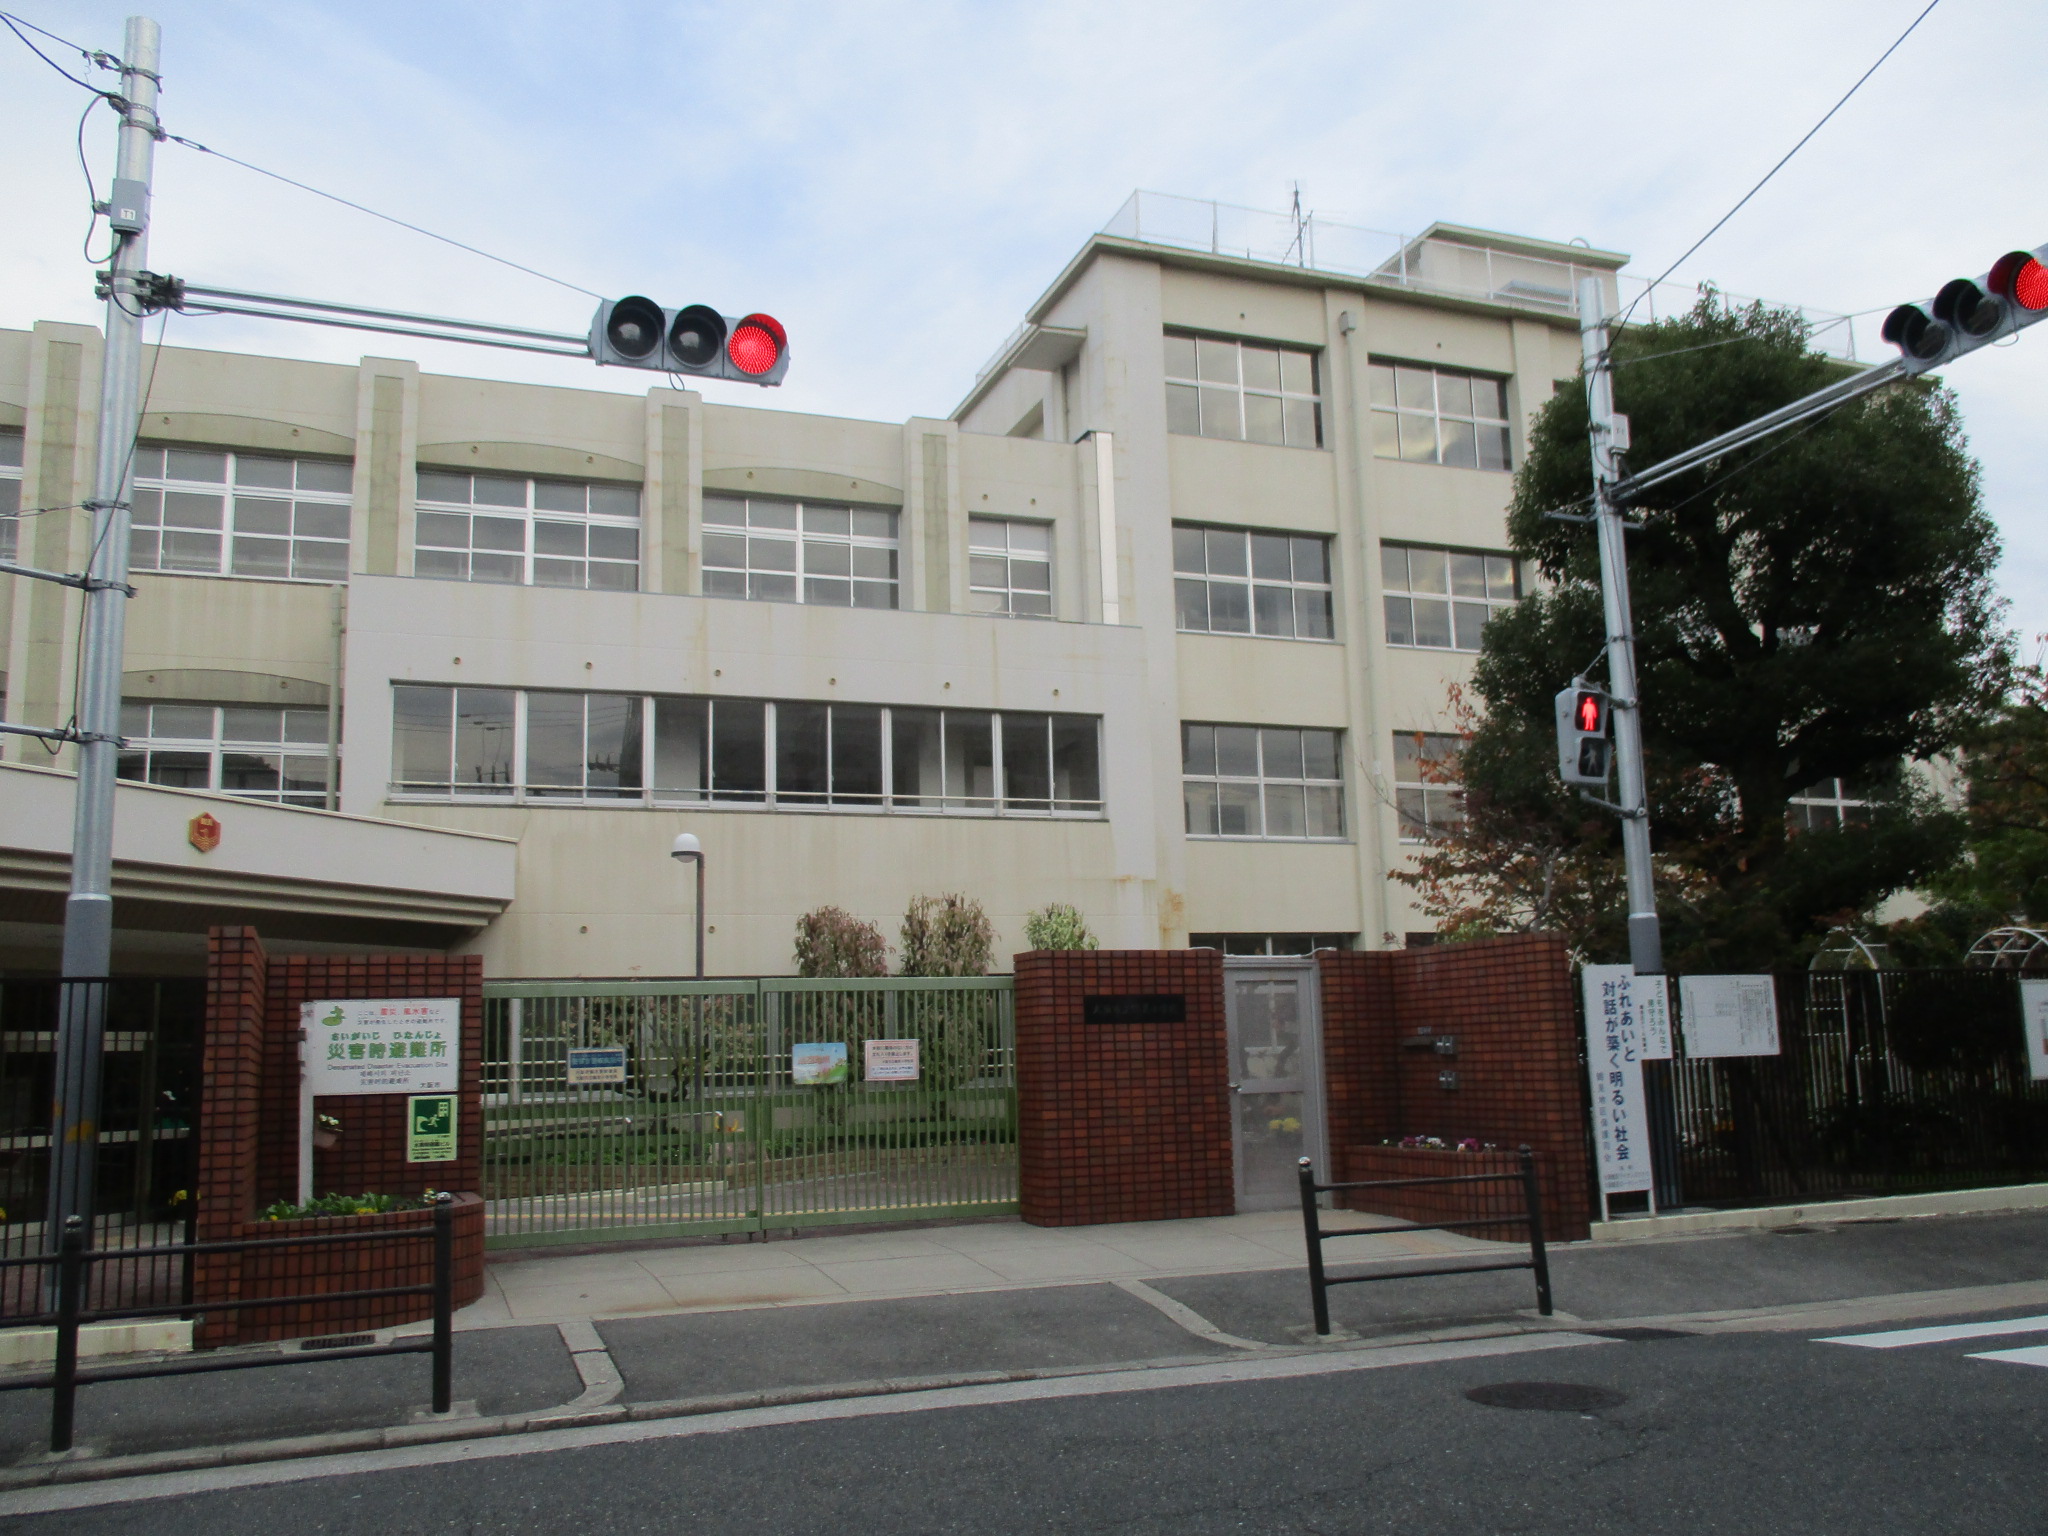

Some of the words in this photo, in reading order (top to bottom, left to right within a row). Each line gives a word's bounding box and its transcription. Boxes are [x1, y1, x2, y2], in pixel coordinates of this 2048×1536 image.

[331, 1031, 380, 1041] さいがいじ
[393, 1030, 442, 1040] ひなんじょ
[1618, 975, 1635, 1062] ふれあいと
[326, 1041, 447, 1060] 災害時避難所
[1602, 981, 1629, 1161] 対話が築く明るい社会
